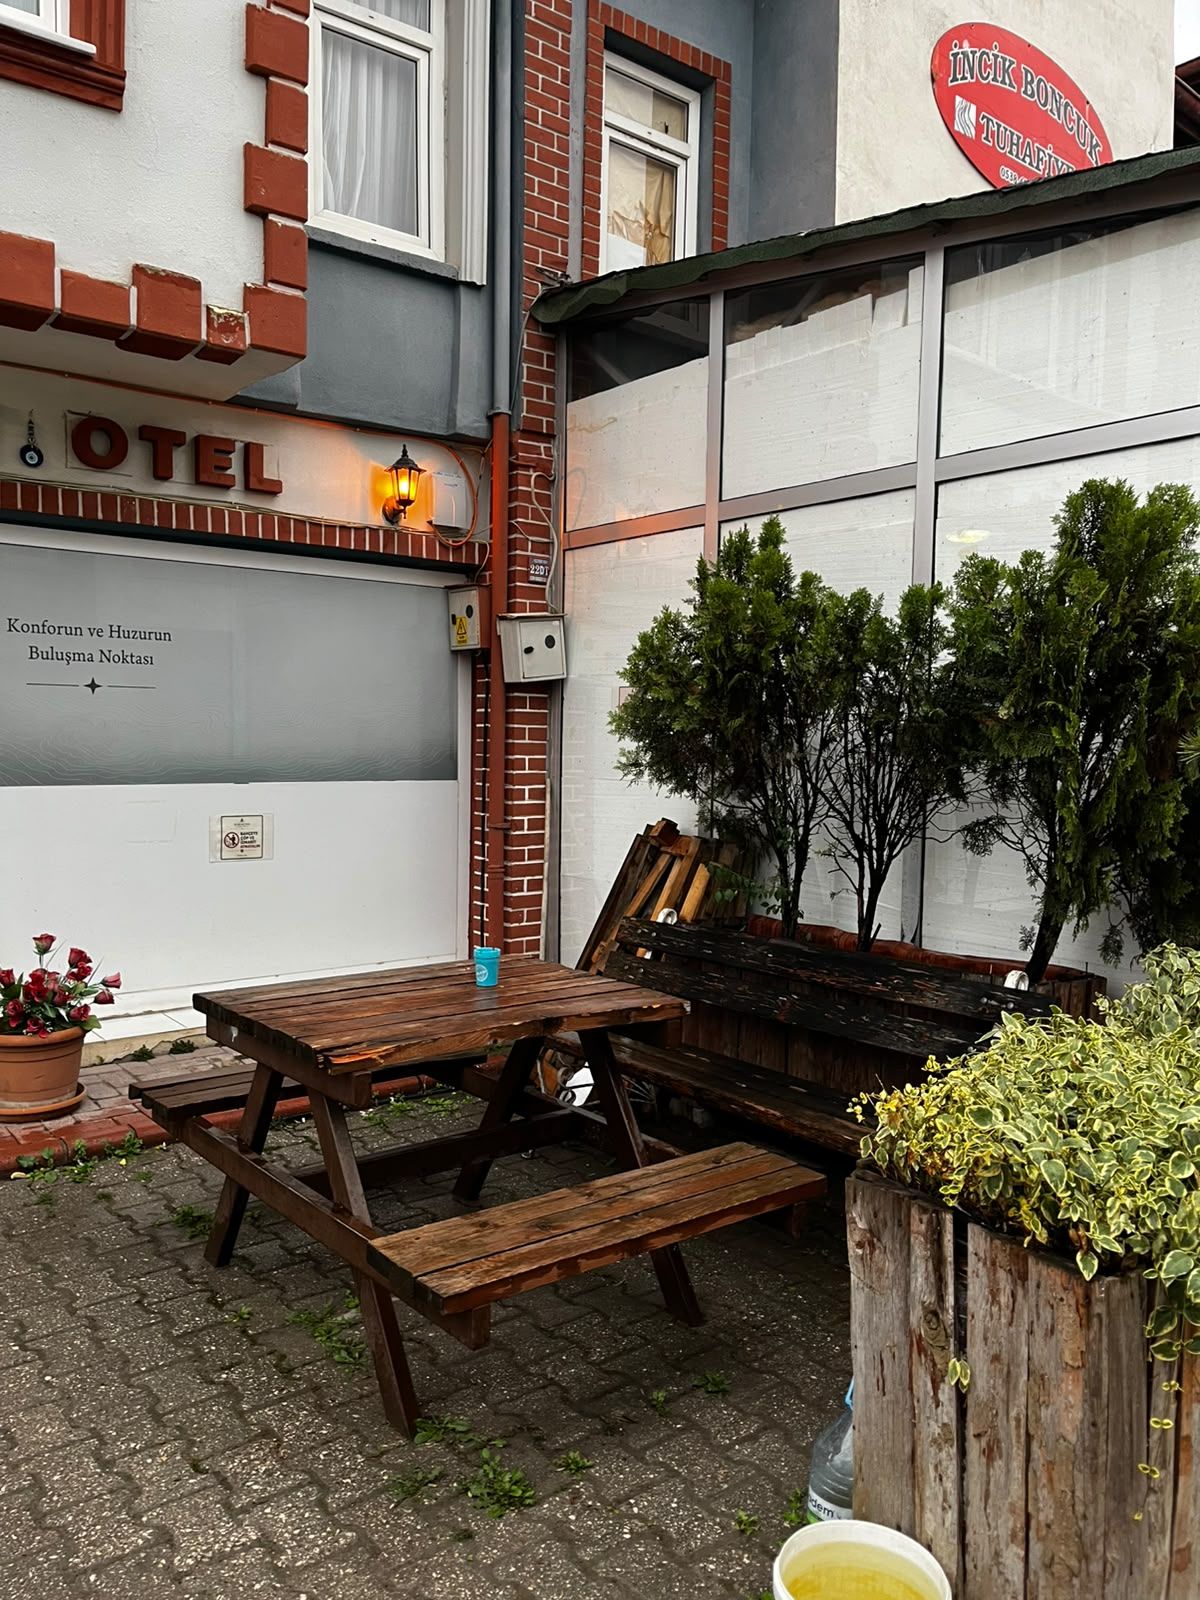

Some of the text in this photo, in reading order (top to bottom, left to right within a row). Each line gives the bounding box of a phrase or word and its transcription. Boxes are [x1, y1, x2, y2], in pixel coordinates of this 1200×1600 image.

[948, 40, 1102, 167] İNCİK BONCUK
[71, 416, 283, 495] OTEL
[7, 617, 173, 642] Konforun ve Huzurun
[28, 645, 155, 666] Buluşma Noktası
